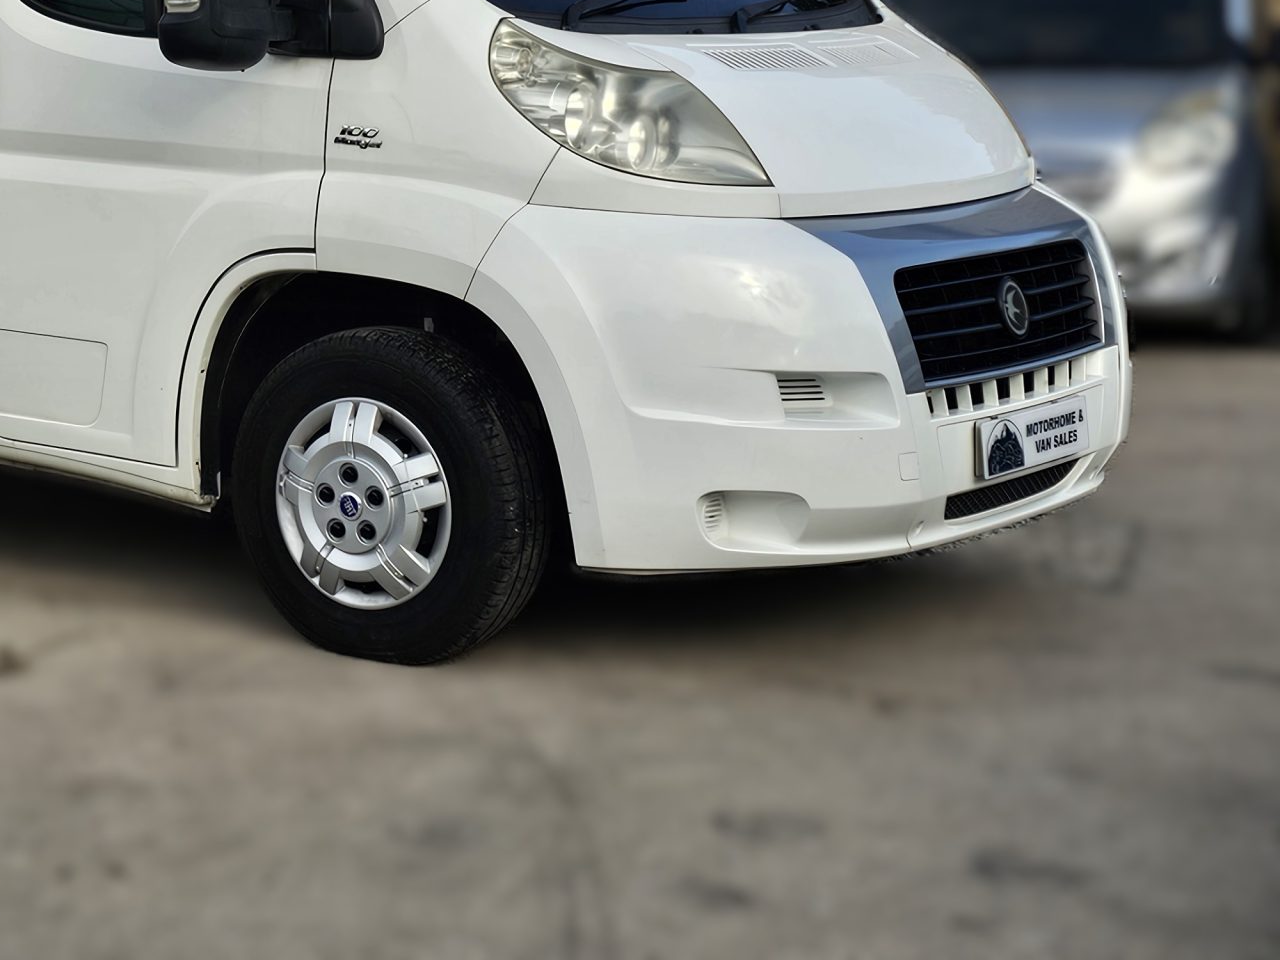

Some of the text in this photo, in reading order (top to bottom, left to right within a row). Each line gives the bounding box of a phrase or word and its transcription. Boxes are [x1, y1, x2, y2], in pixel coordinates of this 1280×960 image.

[1026, 409, 1084, 437] MOTORHOME &
[1035, 429, 1078, 453] VAN SALES
